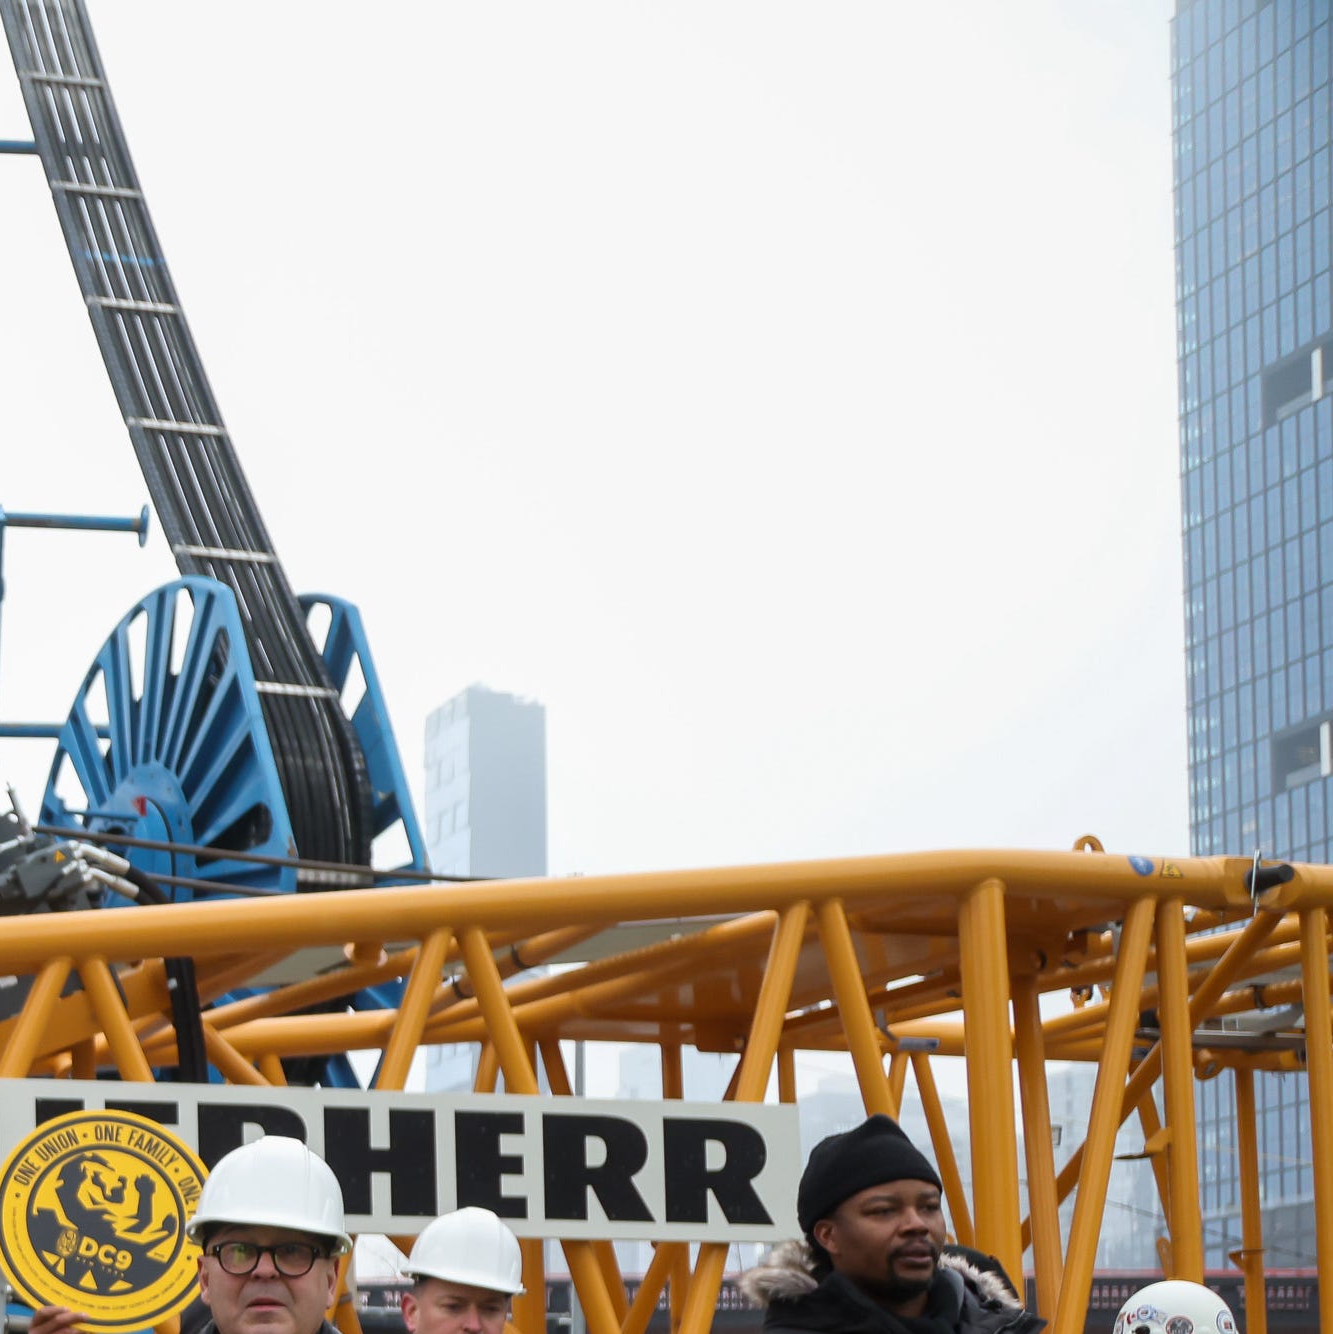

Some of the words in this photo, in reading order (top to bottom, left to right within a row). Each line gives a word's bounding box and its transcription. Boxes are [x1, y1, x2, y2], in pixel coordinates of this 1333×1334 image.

[13, 1156, 41, 1186] ONE
[35, 1128, 79, 1161] UNION
[94, 1124, 123, 1143] ONE
[127, 1128, 180, 1168] FAMILY
[78, 1235, 132, 1271] DC9
